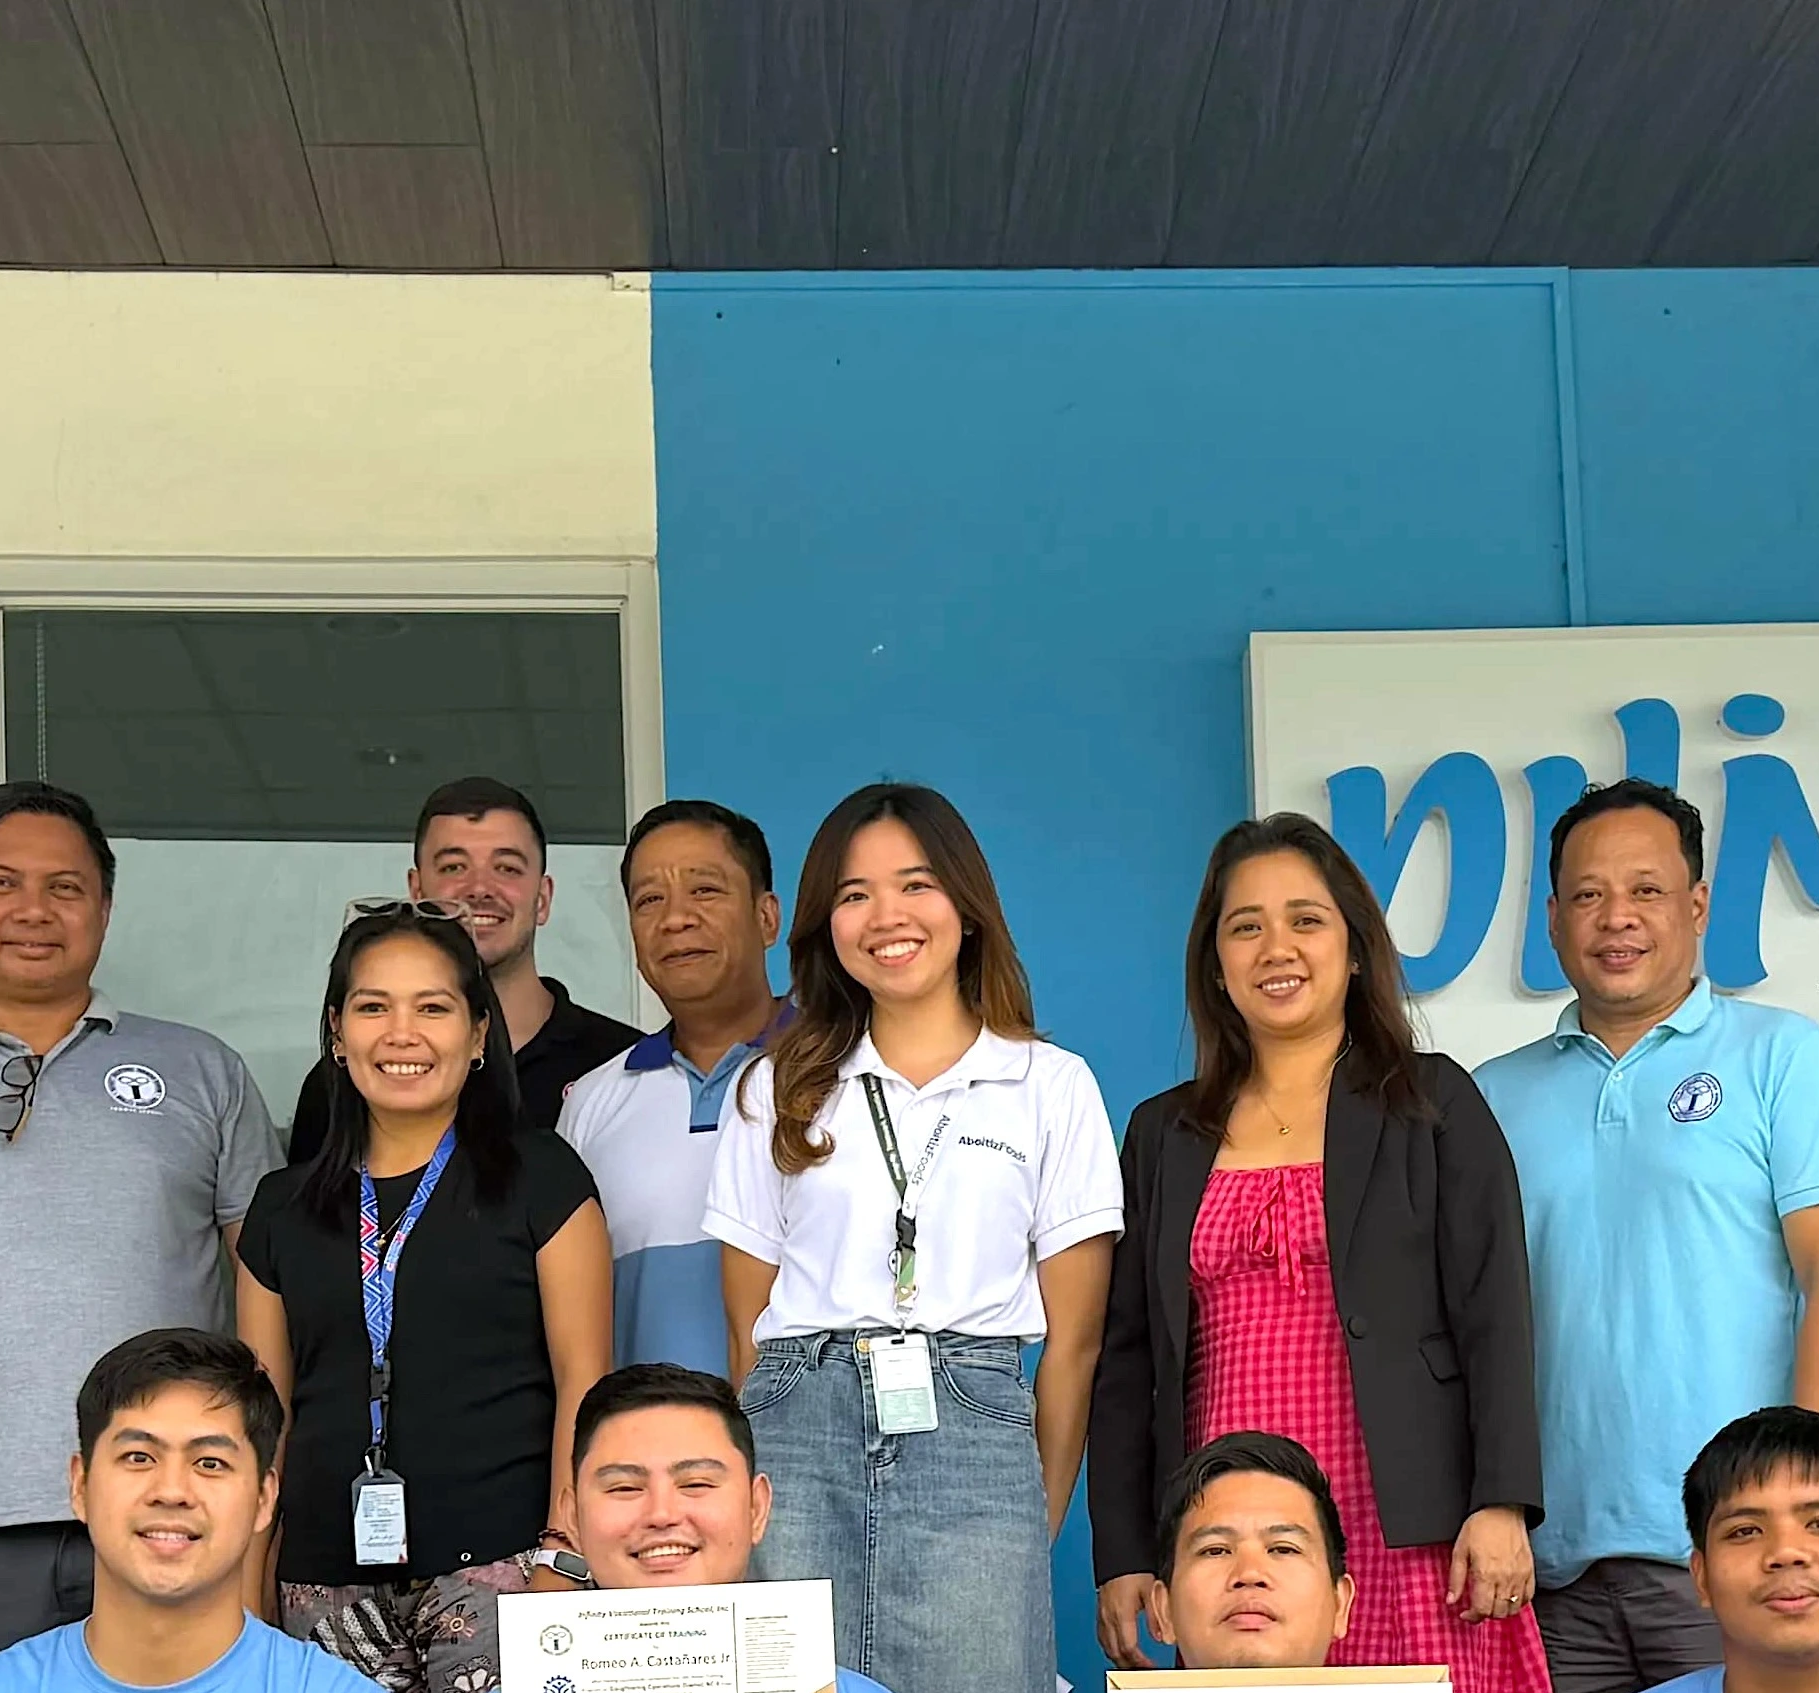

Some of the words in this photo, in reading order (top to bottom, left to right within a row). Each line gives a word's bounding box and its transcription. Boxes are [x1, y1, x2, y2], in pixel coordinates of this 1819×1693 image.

[911, 1114, 951, 1186] AboitizFoods
[958, 1136, 1027, 1163] AboitizFoods
[581, 1657, 626, 1670] Romeo
